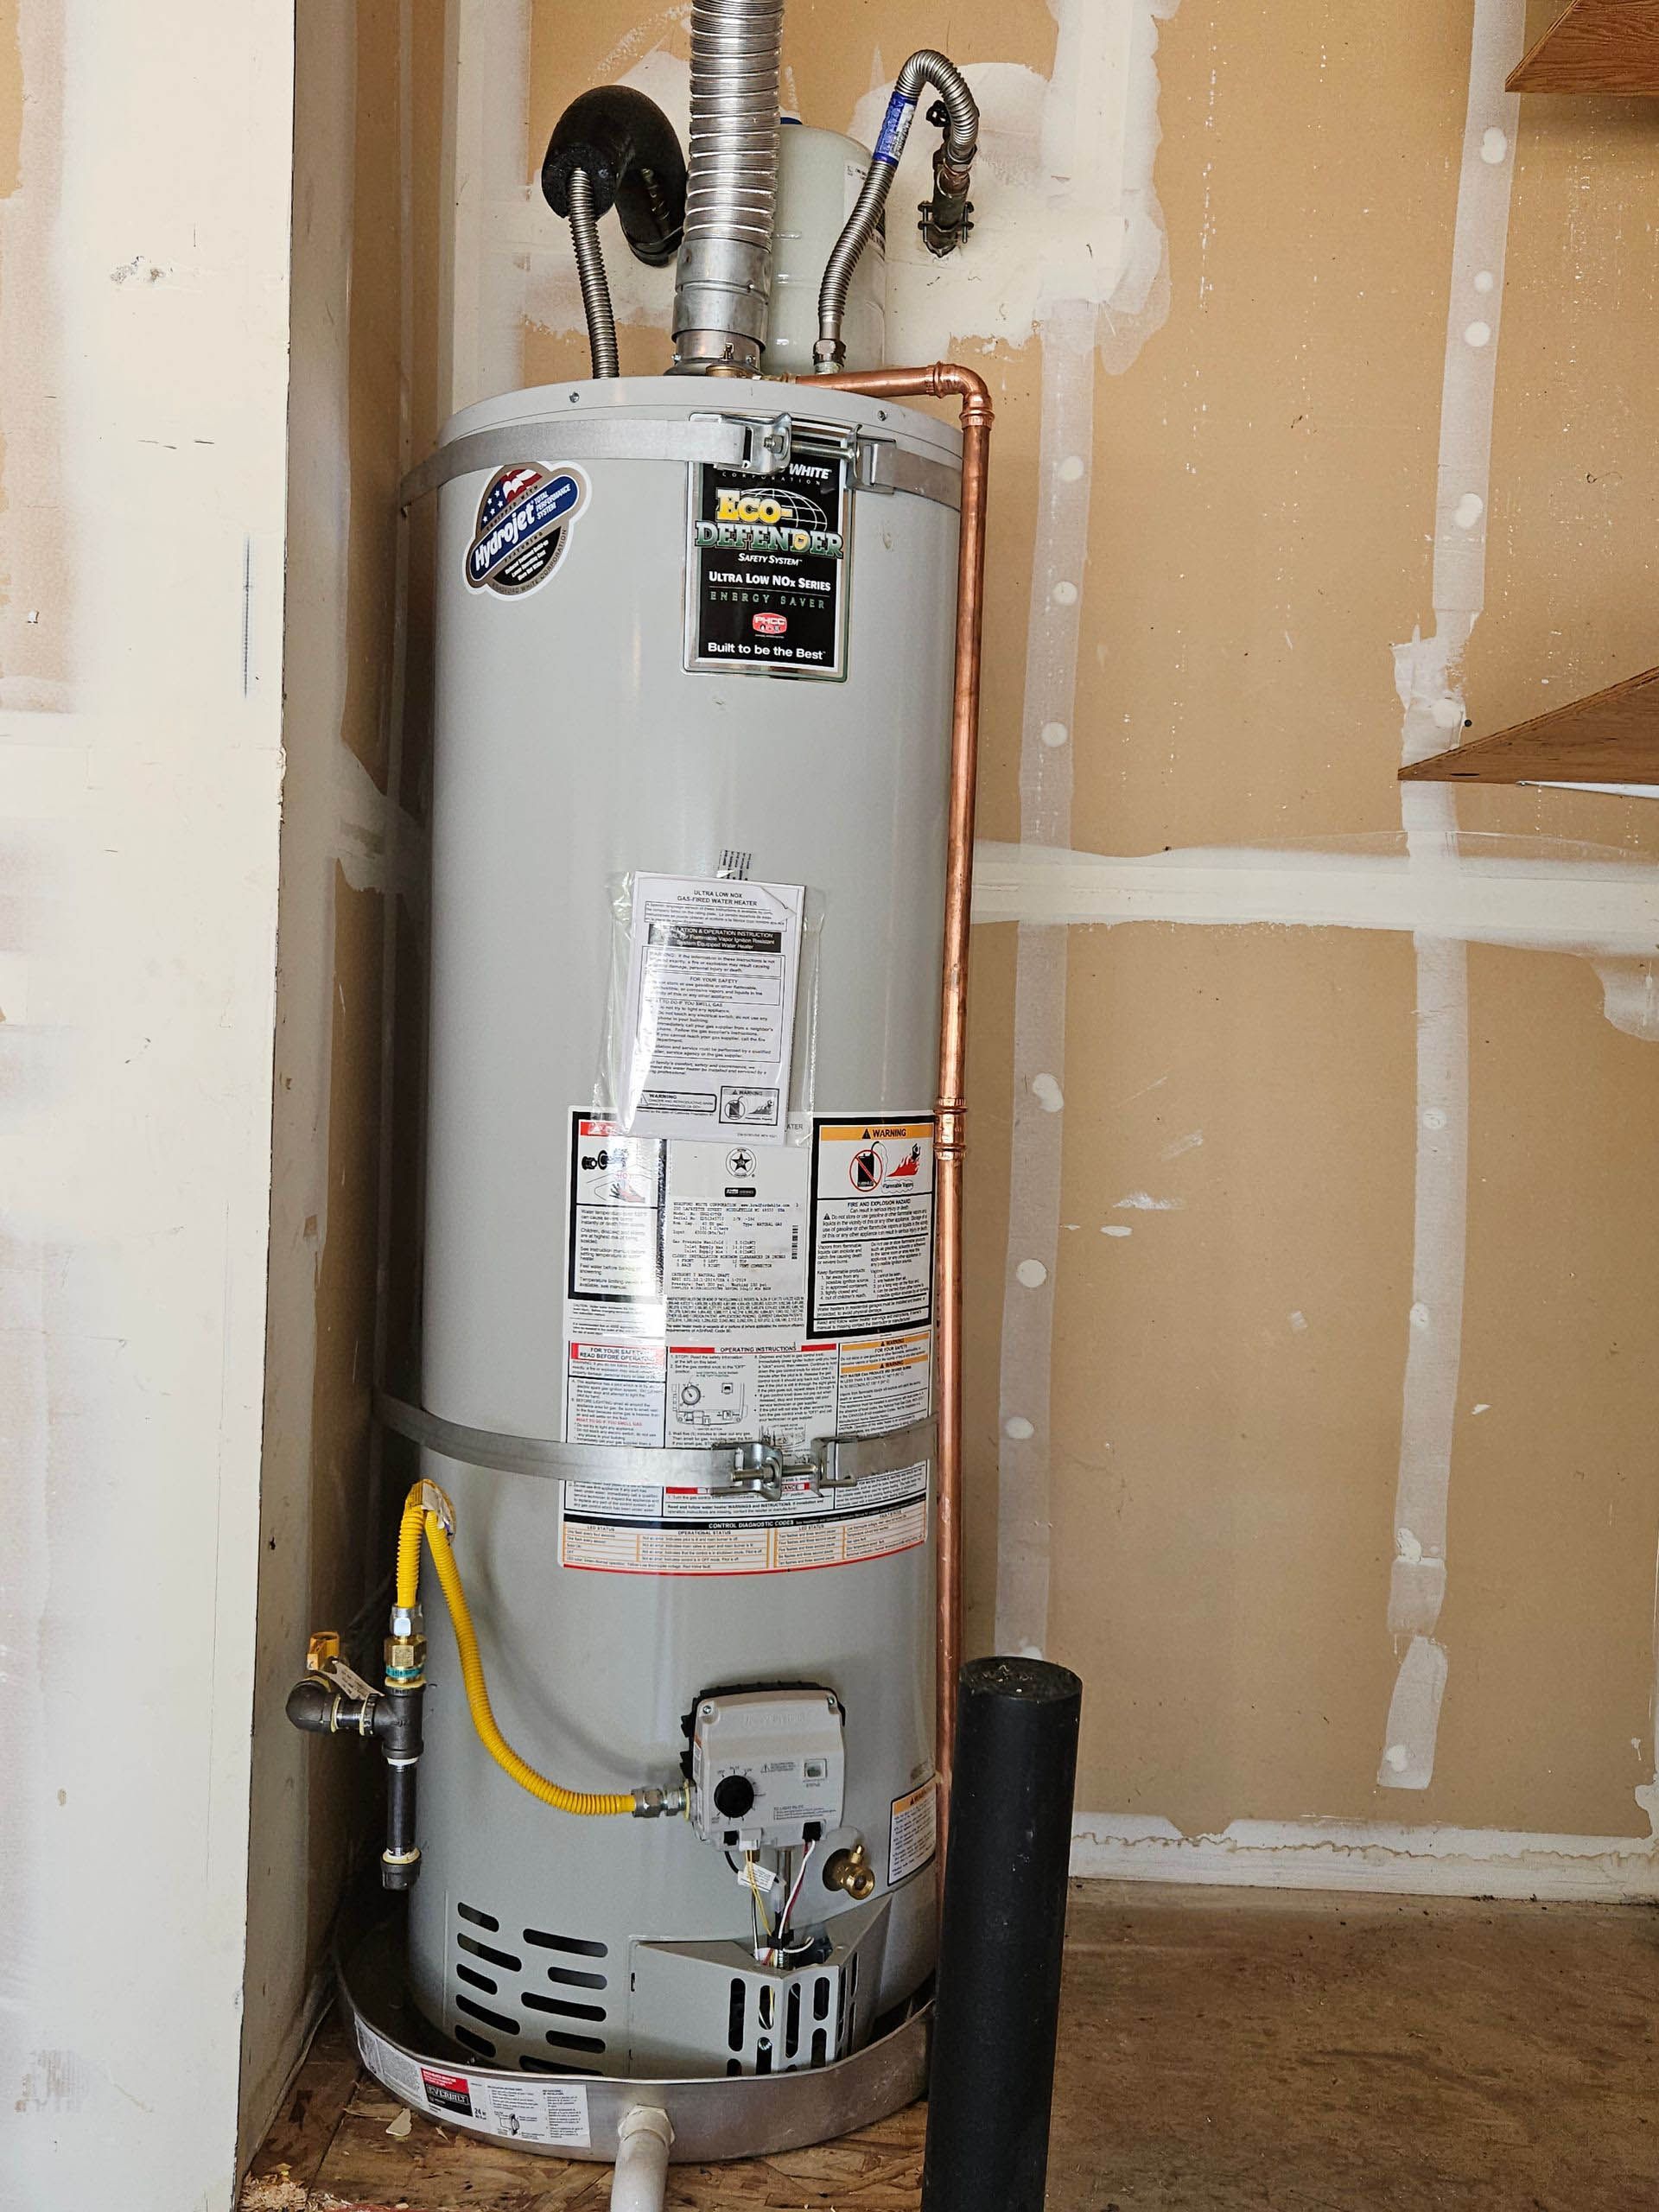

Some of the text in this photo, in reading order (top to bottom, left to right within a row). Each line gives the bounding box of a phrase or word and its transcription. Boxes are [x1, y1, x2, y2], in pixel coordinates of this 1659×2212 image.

[789, 463, 830, 479] WHITE
[535, 491, 549, 505] TOTAL
[536, 484, 571, 512] PERFORMANCE
[537, 502, 556, 520] SYSTEM
[475, 503, 535, 571] Hydrojet
[695, 520, 843, 559] DEFENDER
[738, 553, 768, 563] SAFETY
[709, 571, 743, 583] ULTRA
[746, 575, 770, 586] LOW
[798, 578, 831, 592] SERIES
[709, 591, 824, 608] ENERGY SAVER
[754, 616, 785, 625] PHCC
[708, 643, 823, 659] Built to be the Best
[677, 895, 710, 904] GAS-FIRED
[873, 1128, 906, 1138] WARNING
